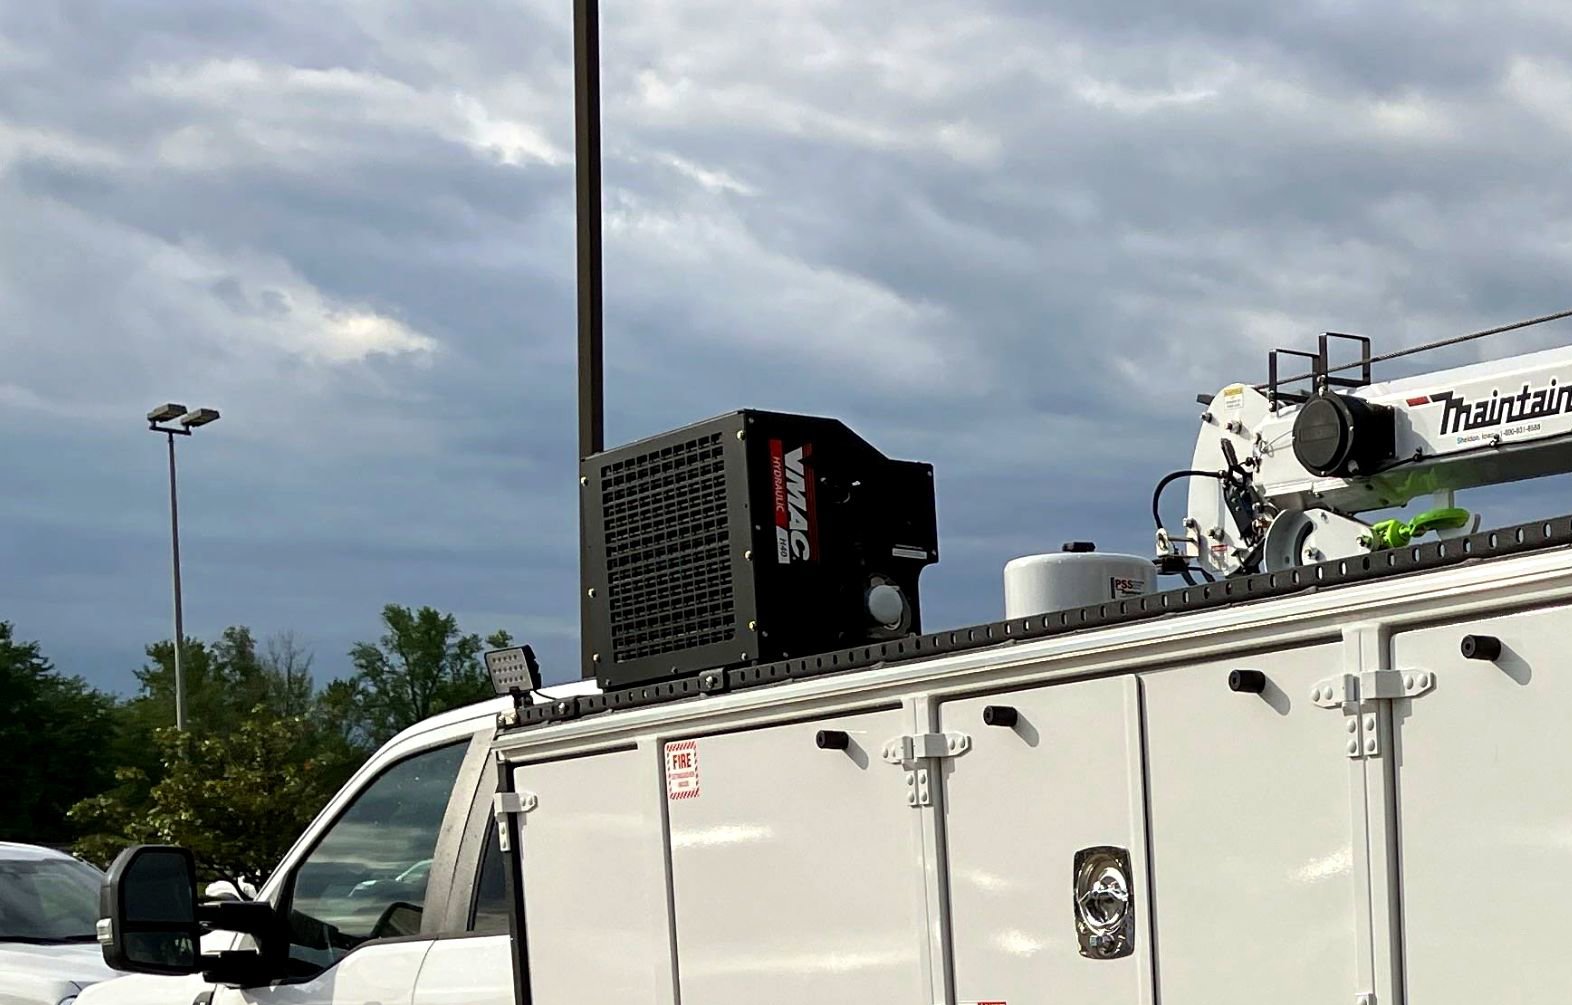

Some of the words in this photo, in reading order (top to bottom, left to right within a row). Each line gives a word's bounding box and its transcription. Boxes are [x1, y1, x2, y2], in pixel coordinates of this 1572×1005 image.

[772, 456, 785, 512] HYDRAULIC
[784, 446, 810, 561] VMAC
[779, 537, 788, 558] H40
[1115, 579, 1133, 589] PSS
[672, 753, 692, 770] FIRE
